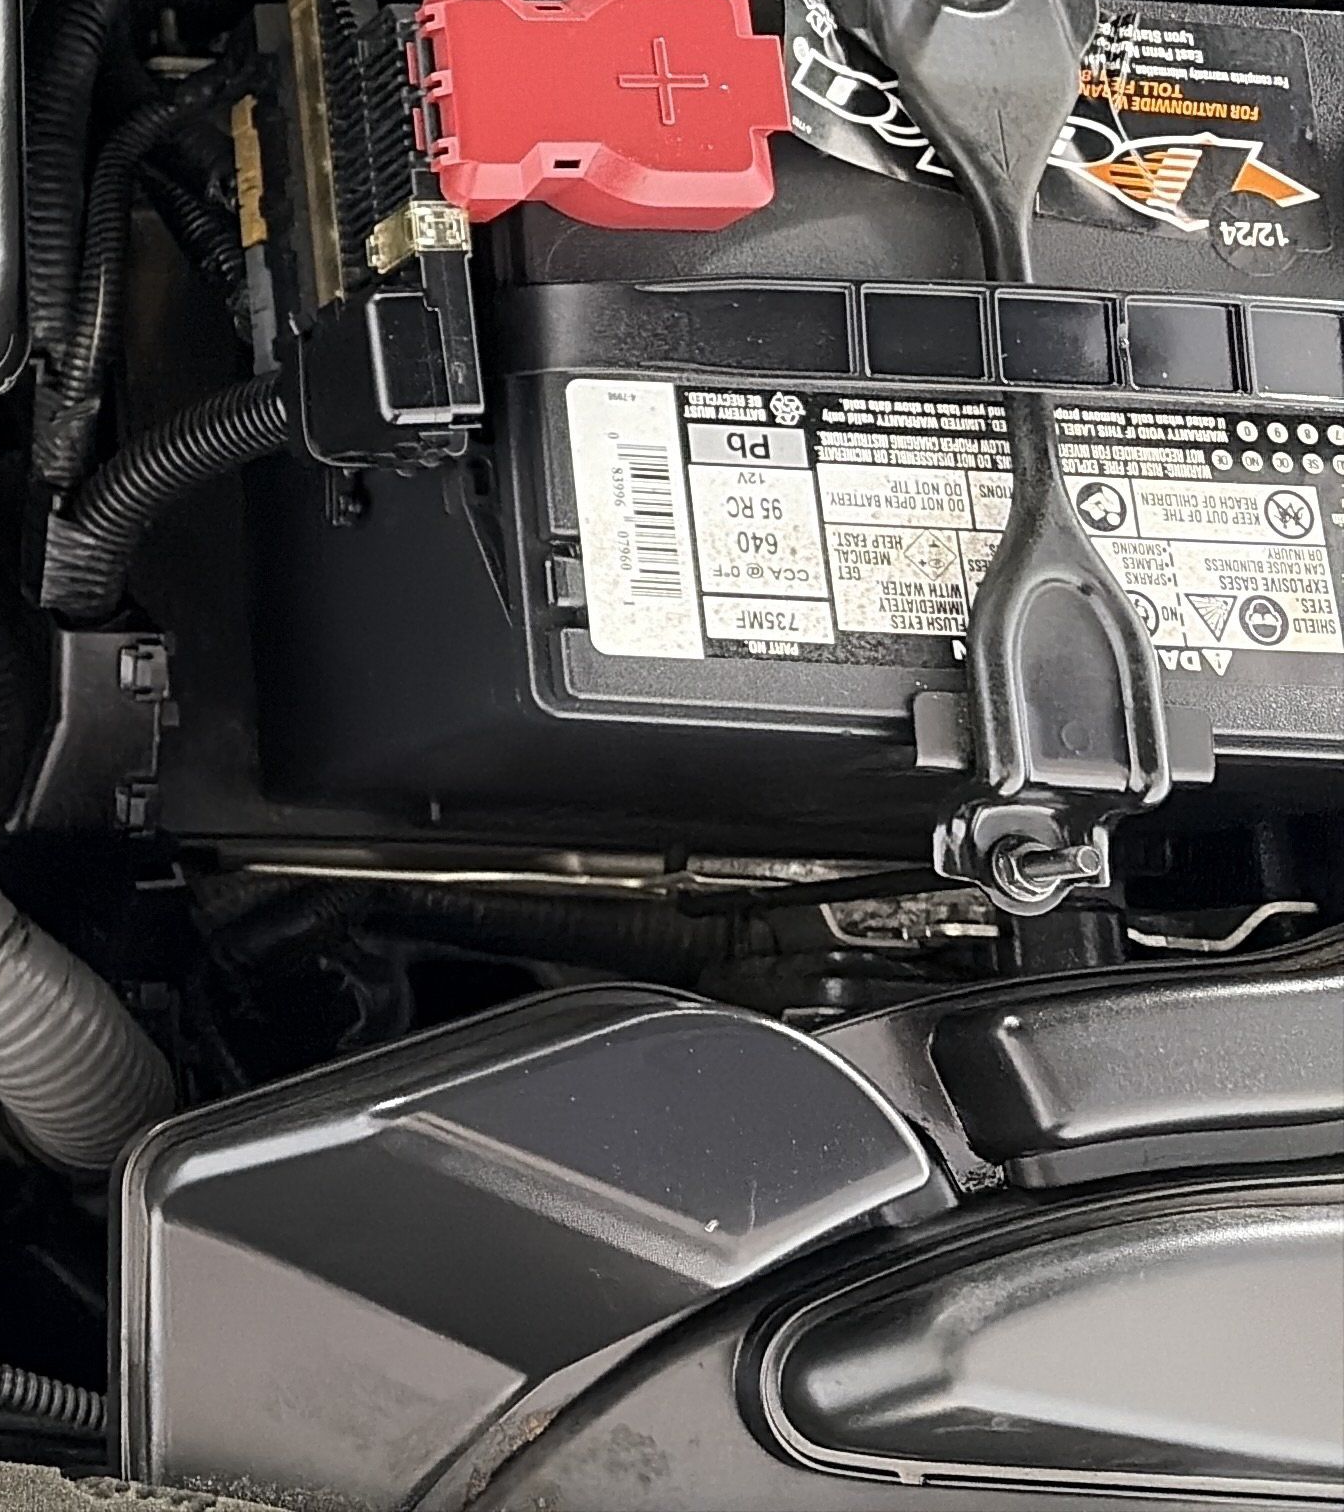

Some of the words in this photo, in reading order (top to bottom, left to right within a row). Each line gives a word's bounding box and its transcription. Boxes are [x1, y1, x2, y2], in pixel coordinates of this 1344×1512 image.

[1163, 30, 1194, 47] Lyon
[1141, 46, 1174, 61] Penn
[1175, 49, 1204, 63] East
[1141, 81, 1184, 99] TOLL
[1131, 98, 1228, 120] NATIONWIDE
[1230, 105, 1259, 121] FOR
[1219, 220, 1289, 248] 12/24
[748, 395, 762, 408] BE
[924, 402, 936, 415] to
[684, 405, 716, 420] MUST
[718, 407, 766, 422] BATTERY
[822, 408, 845, 424] only
[876, 414, 939, 430] WARRANTY
[941, 417, 986, 432] LIMITED
[1064, 422, 1096, 437] LABEL
[1098, 424, 1123, 439] THIS
[1125, 426, 1137, 439] IF
[1138, 427, 1166, 441] VOID
[1168, 428, 1229, 444] WARRANTY
[726, 432, 770, 459] Pb
[890, 434, 939, 451] CHARGING
[940, 437, 978, 454] PROPER
[874, 449, 889, 464] OR
[889, 450, 955, 468] DISASSEMBLE
[1091, 444, 1112, 460] FOR
[1112, 445, 1185, 464] RECOMMENDED
[1186, 449, 1206, 464] NOT
[956, 453, 976, 468] NOT
[977, 454, 992, 469] DO
[1217, 454, 1229, 466] DE
[1244, 456, 1260, 467] NO
[1307, 458, 1320, 470] SE
[1127, 461, 1140, 477] OF
[1141, 461, 1164, 477] RISK
[738, 472, 766, 485] 12V
[612, 467, 627, 507] 83996
[915, 481, 940, 496] NOT
[945, 482, 962, 497] DO
[826, 491, 881, 508] BATTERY.
[885, 495, 917, 510] OPEN
[920, 497, 944, 512] NOT
[948, 498, 965, 512] DO
[1137, 491, 1198, 508] CHILDREN.
[1202, 495, 1216, 508] OF
[1219, 495, 1258, 511] REACH
[726, 496, 754, 519] RC
[760, 498, 783, 520] 95
[1163, 508, 1184, 522] THE
[1188, 510, 1202, 523] OF
[1205, 511, 1228, 525] OUT
[1232, 512, 1261, 527] KEEP
[737, 531, 778, 555] 640
[833, 531, 868, 548] FAST.
[873, 535, 903, 550] HELP
[616, 530, 633, 571] 07960
[834, 548, 892, 566] MEDICAL
[1308, 549, 1323, 562] OR
[746, 563, 763, 578] @
[838, 565, 861, 581] GET
[1205, 557, 1265, 574] BLINDNESS
[1267, 560, 1302, 575] CAUSE
[1305, 563, 1326, 576] CAN
[768, 567, 809, 582] CCA
[876, 580, 926, 597] WATER.
[929, 583, 962, 598] WITH
[1219, 574, 1260, 592] GASES
[1263, 576, 1330, 595] EXPLOSIVE
[878, 597, 963, 615] IMMEDIATELY
[1295, 597, 1333, 615] EYES.
[736, 610, 799, 631] 735MF
[1162, 606, 1178, 622] NO
[891, 614, 923, 630] EYES
[927, 617, 967, 632] FLUSH
[1293, 618, 1338, 636] SHIELD
[744, 640, 766, 655] NO.
[766, 641, 799, 656] PART
